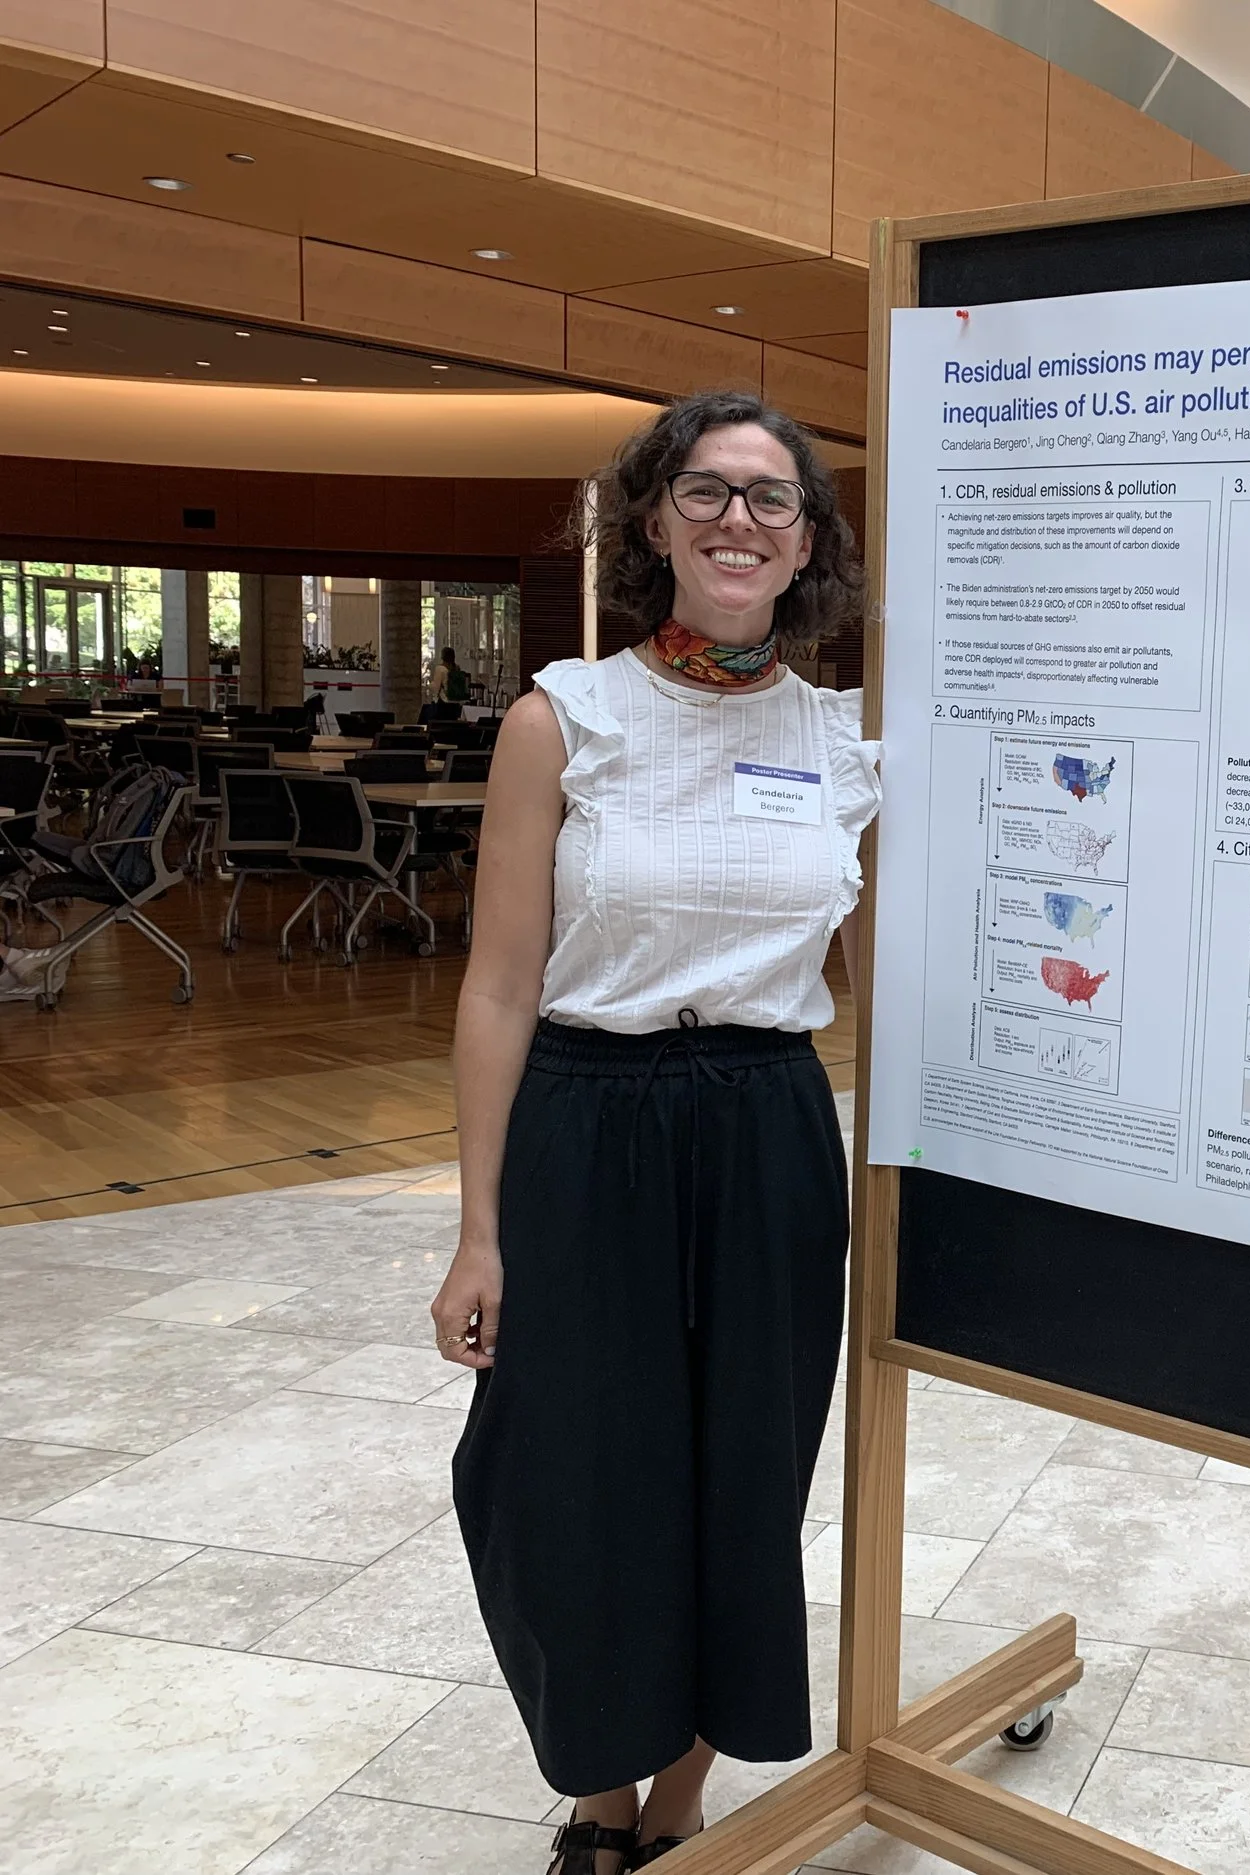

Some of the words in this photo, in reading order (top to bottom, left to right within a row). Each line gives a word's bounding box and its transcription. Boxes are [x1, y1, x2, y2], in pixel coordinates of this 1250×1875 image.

[944, 355, 1032, 384] Residual
[1038, 349, 1146, 378] emissions
[1154, 349, 1204, 375] may
[943, 396, 1058, 429] inequalities
[1065, 393, 1086, 418] of
[1092, 390, 1136, 417] U.S.
[1144, 389, 1175, 414] air
[941, 438, 992, 451] Candelaria
[1035, 435, 1055, 450] Jing
[1096, 432, 1126, 447] Qiang
[1171, 429, 1198, 445] Yang
[940, 484, 951, 499] 1.
[955, 484, 988, 501] CDR,
[992, 482, 1037, 499] residual
[1040, 481, 1101, 498] emissions
[1104, 480, 1114, 496] &
[1117, 479, 1177, 499] pollution
[1234, 478, 1247, 493] 3.
[947, 512, 983, 524] Achieving
[983, 513, 1012, 522] net-zero
[1012, 512, 1045, 521] emissions
[1046, 511, 1071, 523] targets
[1071, 512, 1103, 522] improves
[1104, 510, 1115, 520] air
[1115, 510, 1143, 521] quality,
[1144, 509, 1158, 519] but
[1159, 509, 1173, 519] the
[934, 703, 946, 718] 2.
[949, 704, 1014, 726] Quantifying
[1050, 711, 1096, 729] impacts
[751, 767, 773, 775] Poster
[773, 770, 805, 780] Presenter
[751, 787, 804, 801] Candelaria
[760, 801, 795, 814] Bergero
[1216, 840, 1230, 857] 4.
